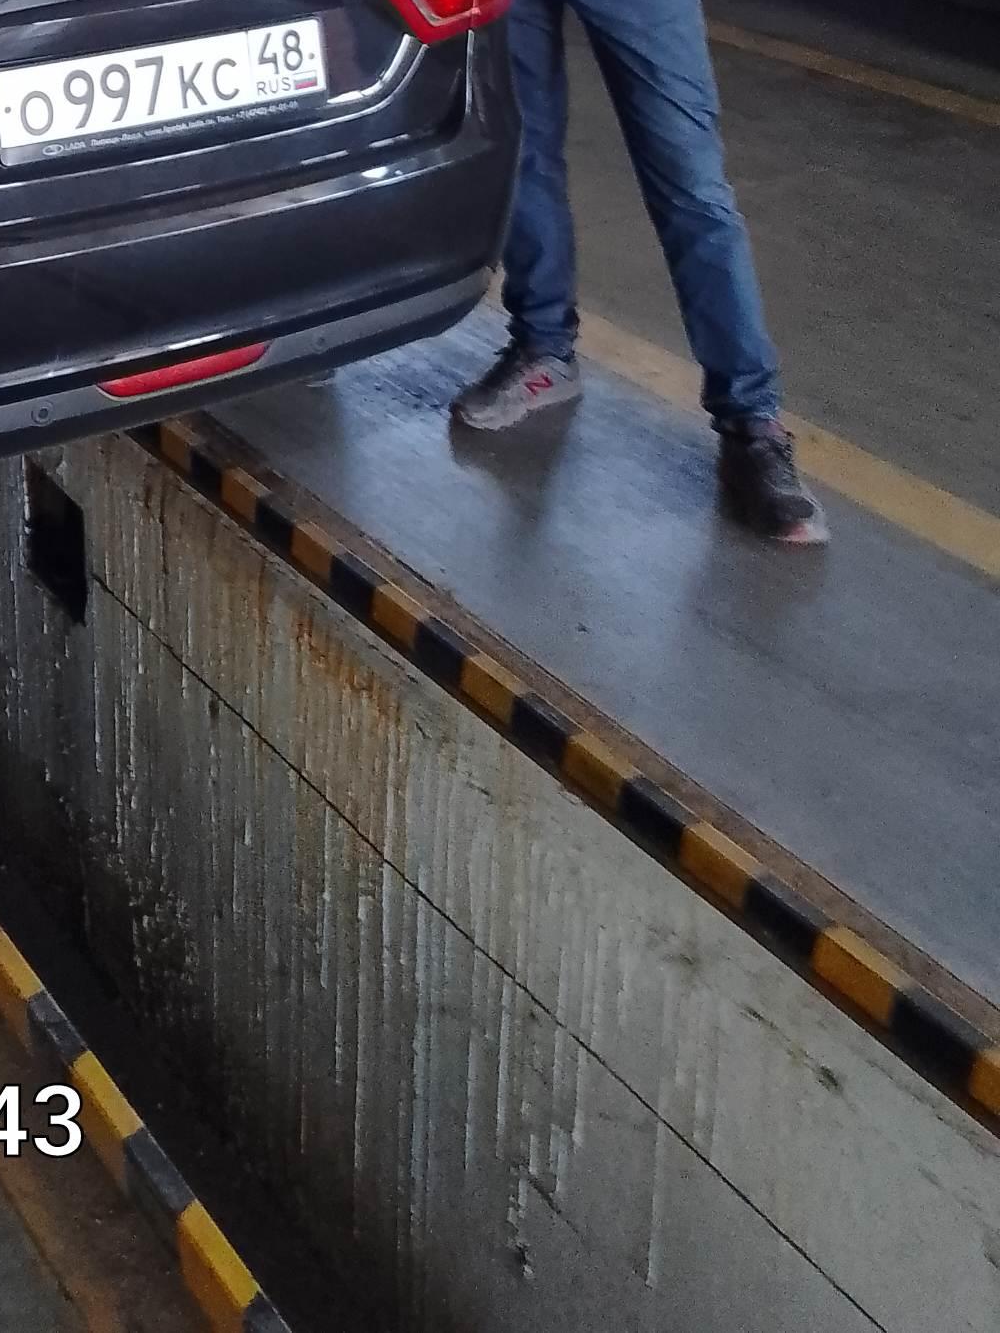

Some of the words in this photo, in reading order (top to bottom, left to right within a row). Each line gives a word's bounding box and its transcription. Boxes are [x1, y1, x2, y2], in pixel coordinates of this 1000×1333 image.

[257, 29, 304, 75] 48
[256, 71, 292, 97] RUS
[64, 141, 86, 152] LADA
